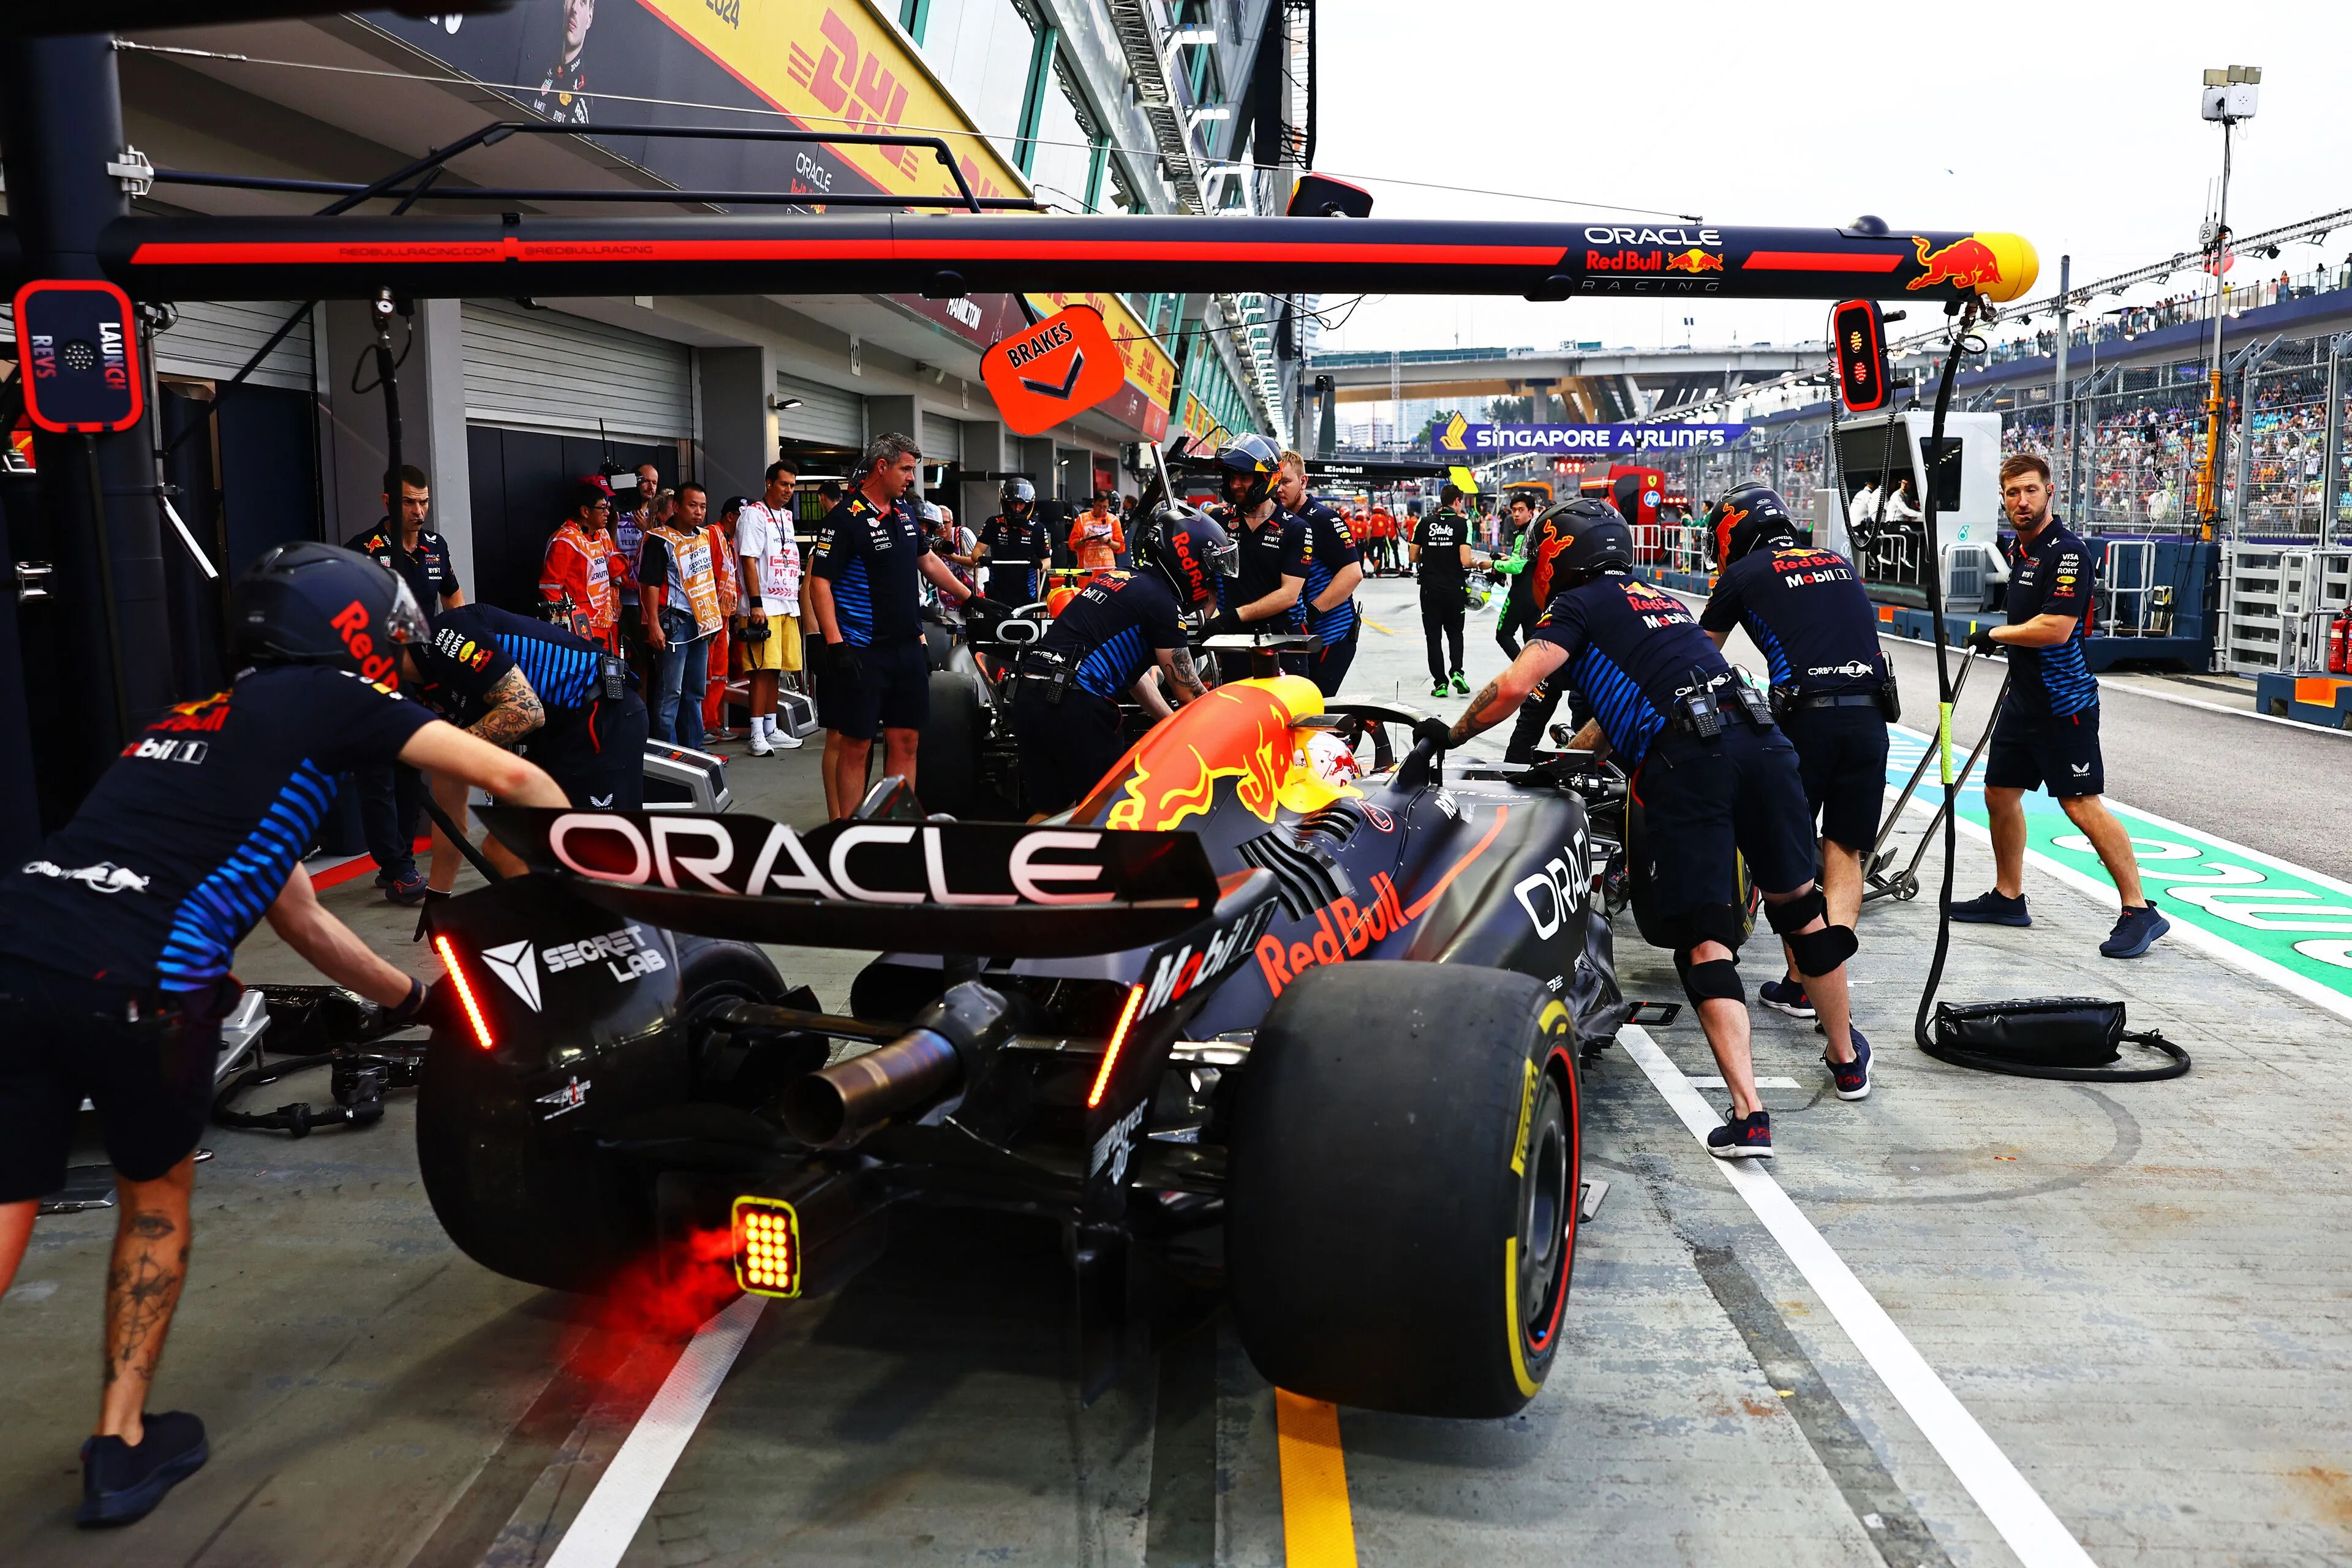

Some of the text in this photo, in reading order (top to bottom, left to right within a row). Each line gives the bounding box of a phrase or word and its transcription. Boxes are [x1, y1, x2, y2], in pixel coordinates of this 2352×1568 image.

[796, 152, 832, 192] ORACLE
[1584, 227, 1723, 246] ORACLE
[2201, 228, 2211, 239] 29
[1586, 249, 1662, 271] Red Bull
[1581, 280, 1720, 292] RACING
[946, 298, 982, 331] HAMILTON
[31, 335, 58, 380] REVS
[98, 322, 127, 390] LAUNCH
[851, 343, 859, 368] 10
[1006, 321, 1073, 369] BRAKES
[1476, 429, 1610, 448] SINGAPORE
[1646, 491, 1659, 507] hp
[1428, 522, 1453, 537] Stake
[1768, 535, 1793, 544] HONDA
[1171, 531, 1199, 571] Red
[1771, 554, 1846, 573] Red Bull
[1103, 577, 1127, 593] Bull
[1785, 569, 1836, 589] Mobil
[1642, 612, 1683, 629] Mobil
[330, 599, 395, 680] Red
[435, 628, 449, 646] VISA
[447, 633, 466, 658] ROKT
[549, 813, 1117, 904] ORACLE
[1513, 815, 1593, 941] ORAC
[1255, 870, 1410, 998] Red Bull
[541, 925, 644, 974] SECRET
[606, 948, 667, 983] LAB
[1136, 917, 1250, 1022] Mobil
